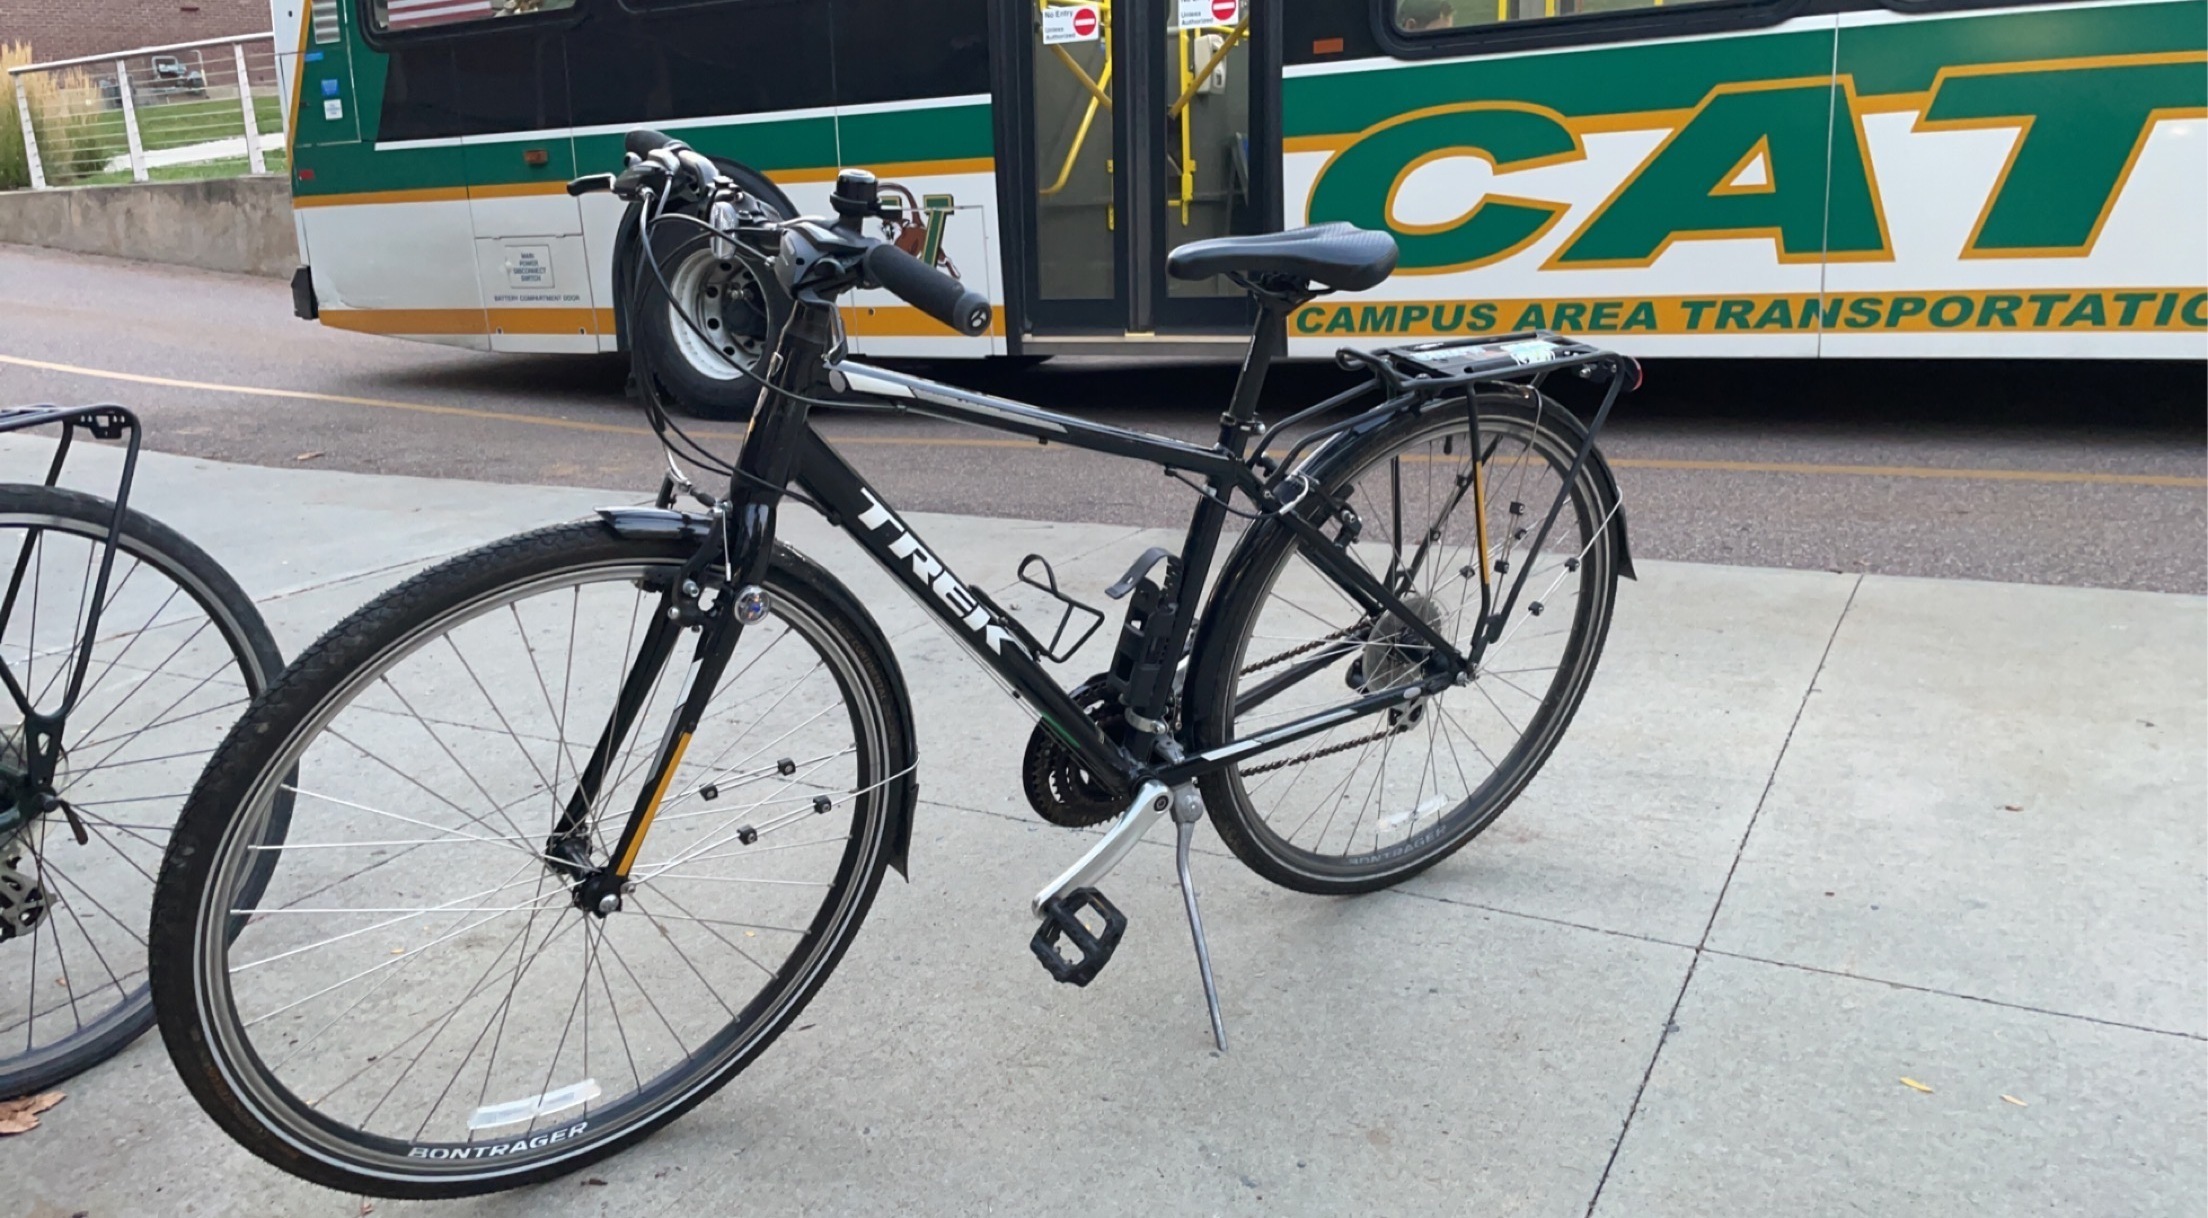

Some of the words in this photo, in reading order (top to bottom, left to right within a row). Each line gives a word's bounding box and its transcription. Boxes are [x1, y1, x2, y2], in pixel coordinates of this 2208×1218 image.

[1044, 10, 1054, 18] No
[1055, 10, 1073, 18] Entry
[1304, 50, 2208, 276] CAT
[1296, 302, 1497, 334] CAMPUS
[1524, 301, 1658, 331] AREA
[857, 486, 1014, 656] TREK
[408, 1121, 588, 1160] BONTRAGER
